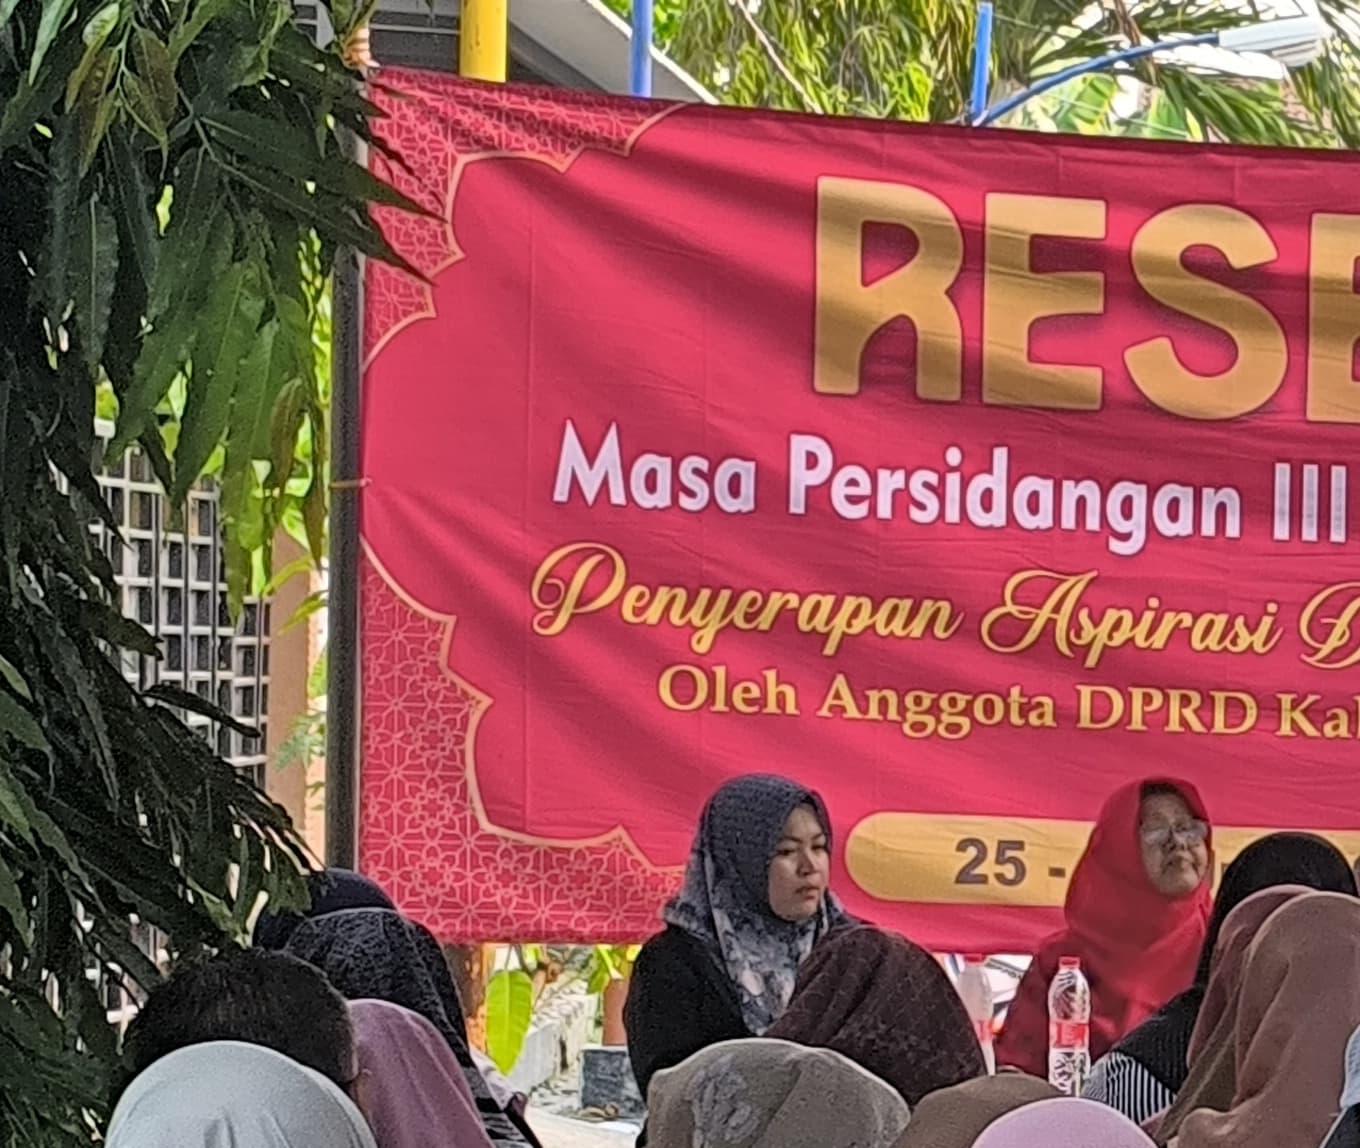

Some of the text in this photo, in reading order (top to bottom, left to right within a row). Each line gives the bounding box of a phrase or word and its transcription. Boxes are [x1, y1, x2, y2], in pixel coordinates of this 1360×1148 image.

[553, 419, 756, 513] Masa
[788, 433, 1241, 555] Persidangan
[1273, 461, 1347, 543] III
[531, 542, 964, 656] Penyerapan
[980, 568, 1283, 669] Aspirasi
[658, 664, 799, 716] Oleh
[816, 673, 1057, 738] Anggota
[1074, 684, 1259, 735] DPRD
[954, 838, 1027, 886] 25
